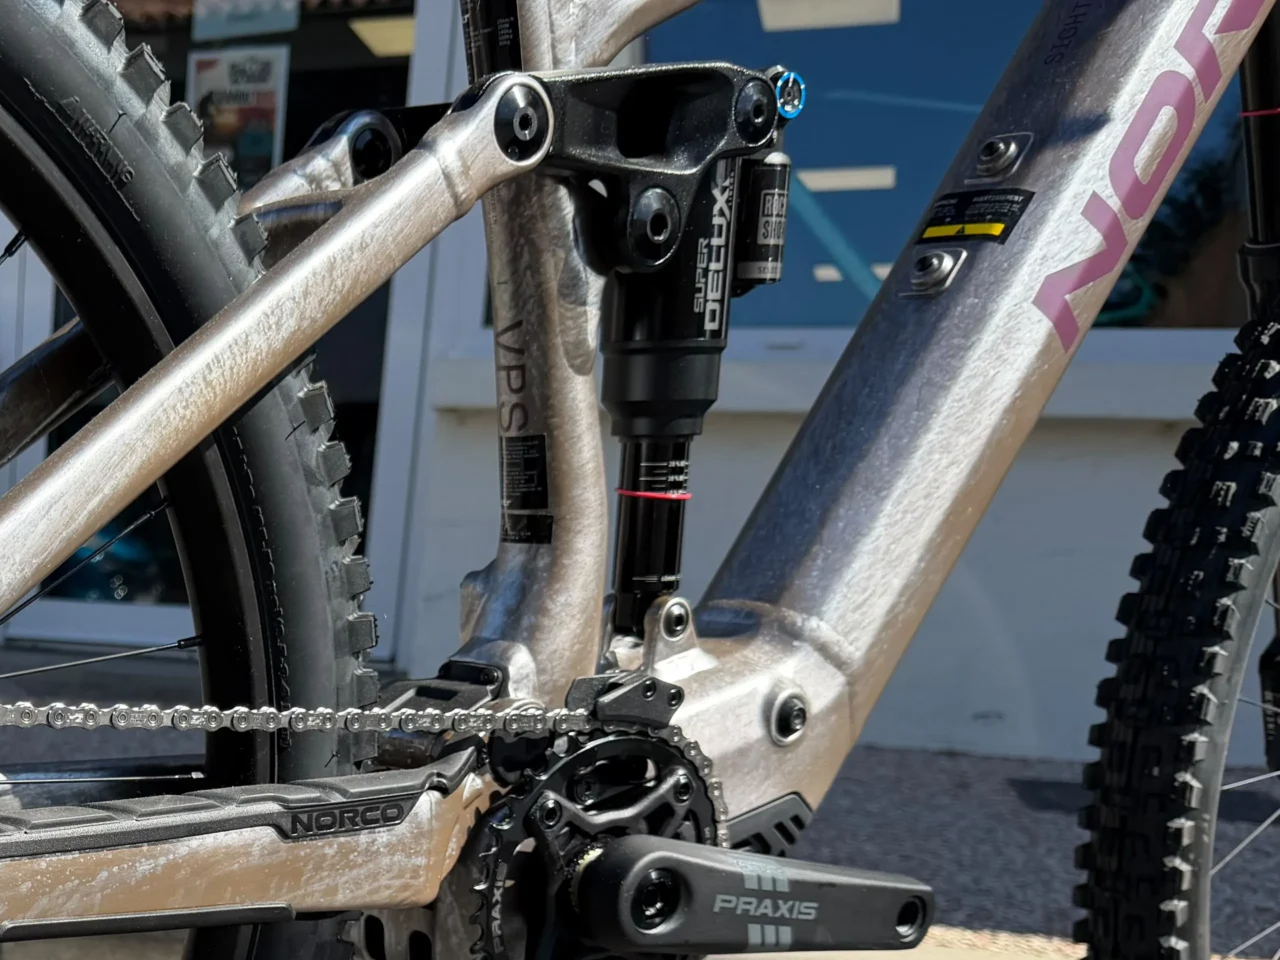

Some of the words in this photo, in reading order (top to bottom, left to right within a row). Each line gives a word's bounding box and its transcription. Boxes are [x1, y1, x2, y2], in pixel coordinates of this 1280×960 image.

[1044, 1, 1092, 65] SIGHT
[764, 195, 787, 215] ROC
[694, 237, 710, 313] SUPER
[496, 319, 529, 434] VPS
[291, 803, 404, 835] NORCO
[713, 894, 819, 920] PRAXIS
